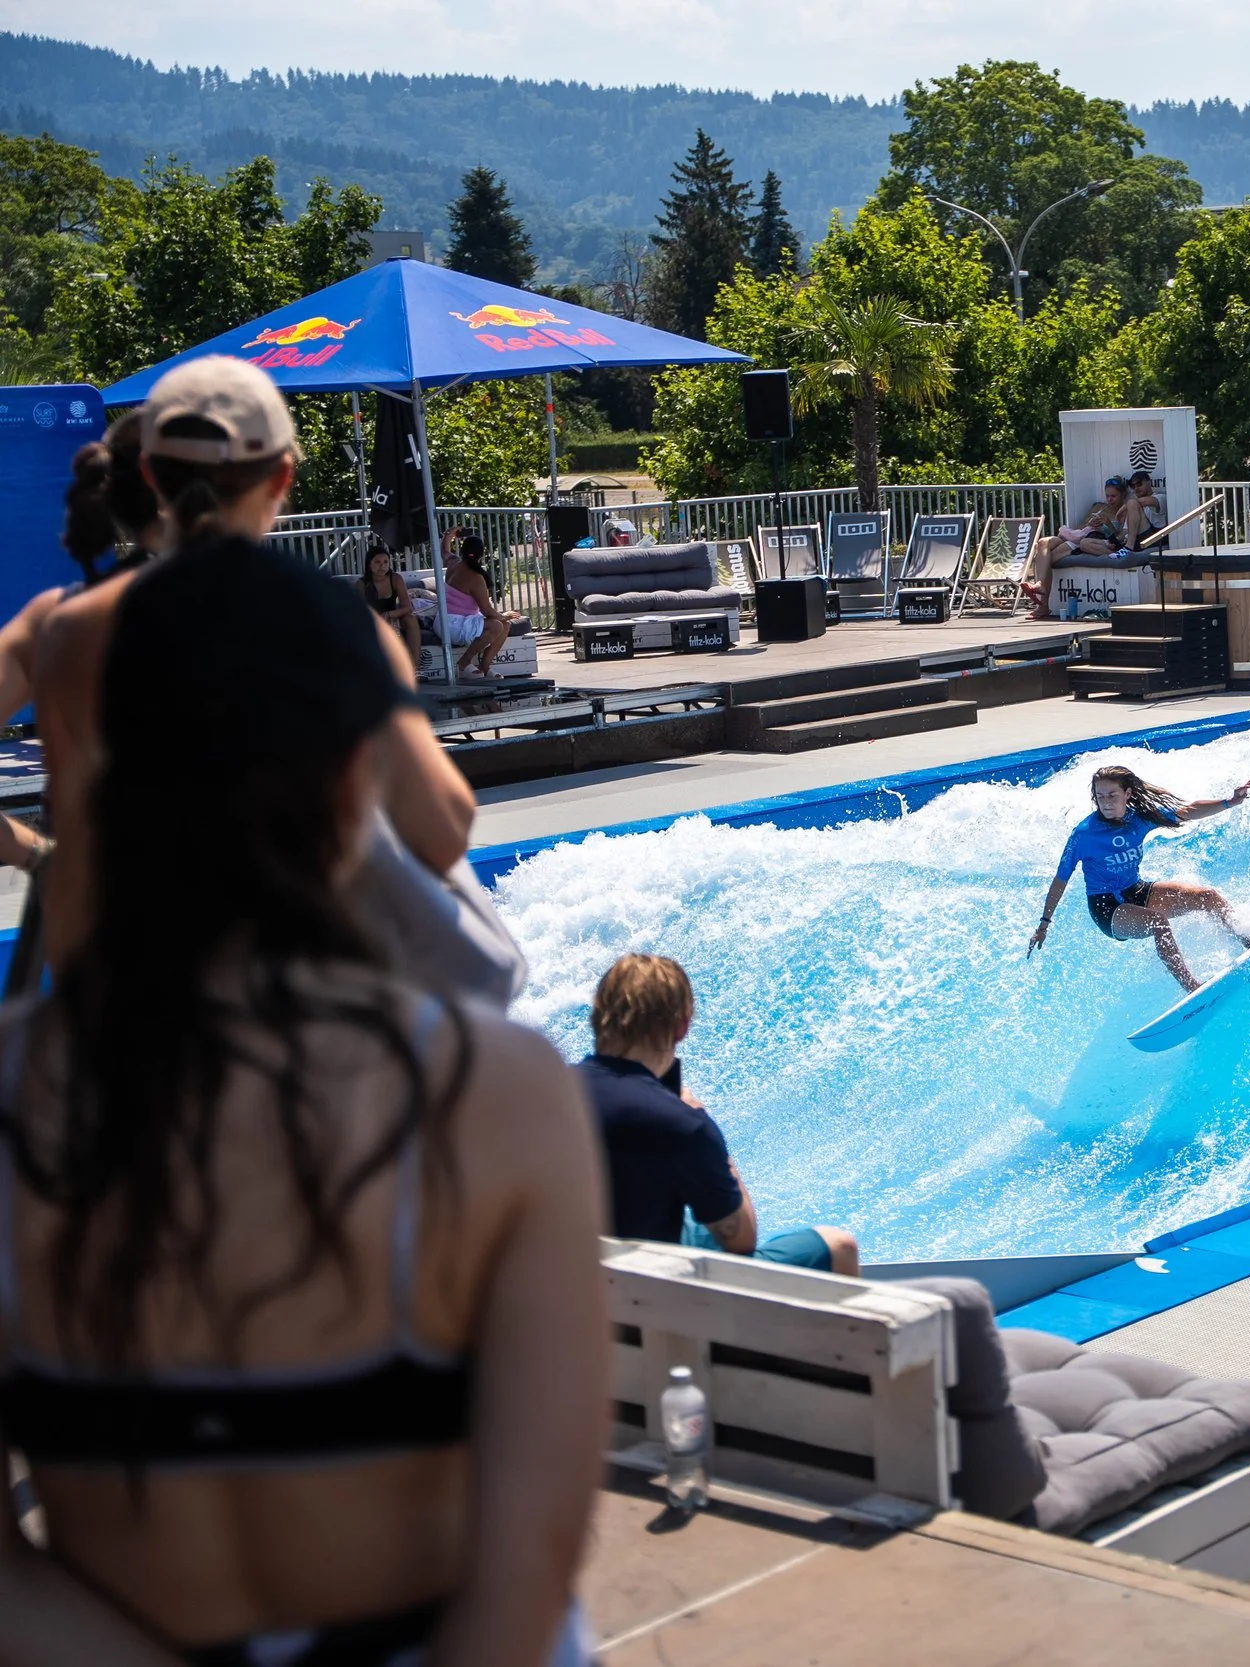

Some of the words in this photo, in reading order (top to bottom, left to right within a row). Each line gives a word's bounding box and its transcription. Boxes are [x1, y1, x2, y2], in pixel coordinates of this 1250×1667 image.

[484, 328, 559, 352] Red
[540, 328, 616, 346] Bull
[260, 344, 343, 368] Bull
[1058, 578, 1118, 603] fritz-kola
[904, 604, 937, 616] fritz-kola
[590, 641, 627, 655] fritz-kola
[689, 633, 723, 647] fritz-kola
